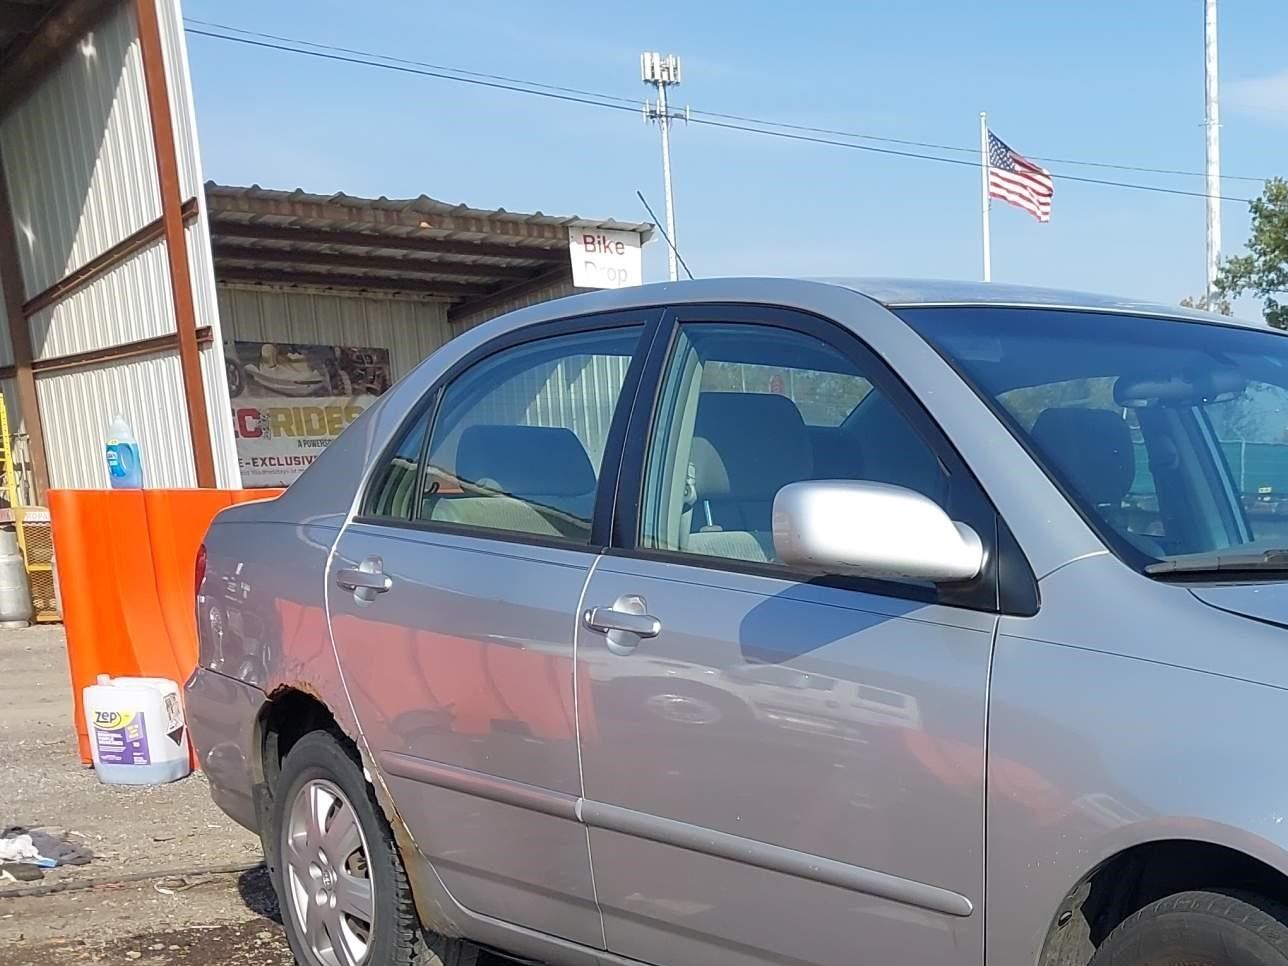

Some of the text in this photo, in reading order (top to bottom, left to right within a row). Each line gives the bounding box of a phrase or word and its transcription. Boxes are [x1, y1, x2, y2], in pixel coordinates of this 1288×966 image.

[583, 234, 625, 256] Bike
[584, 260, 628, 287] Dop
[232, 408, 263, 438] C
[303, 439, 332, 448] POWERS
[239, 456, 318, 468] E-EXCLUSIV
